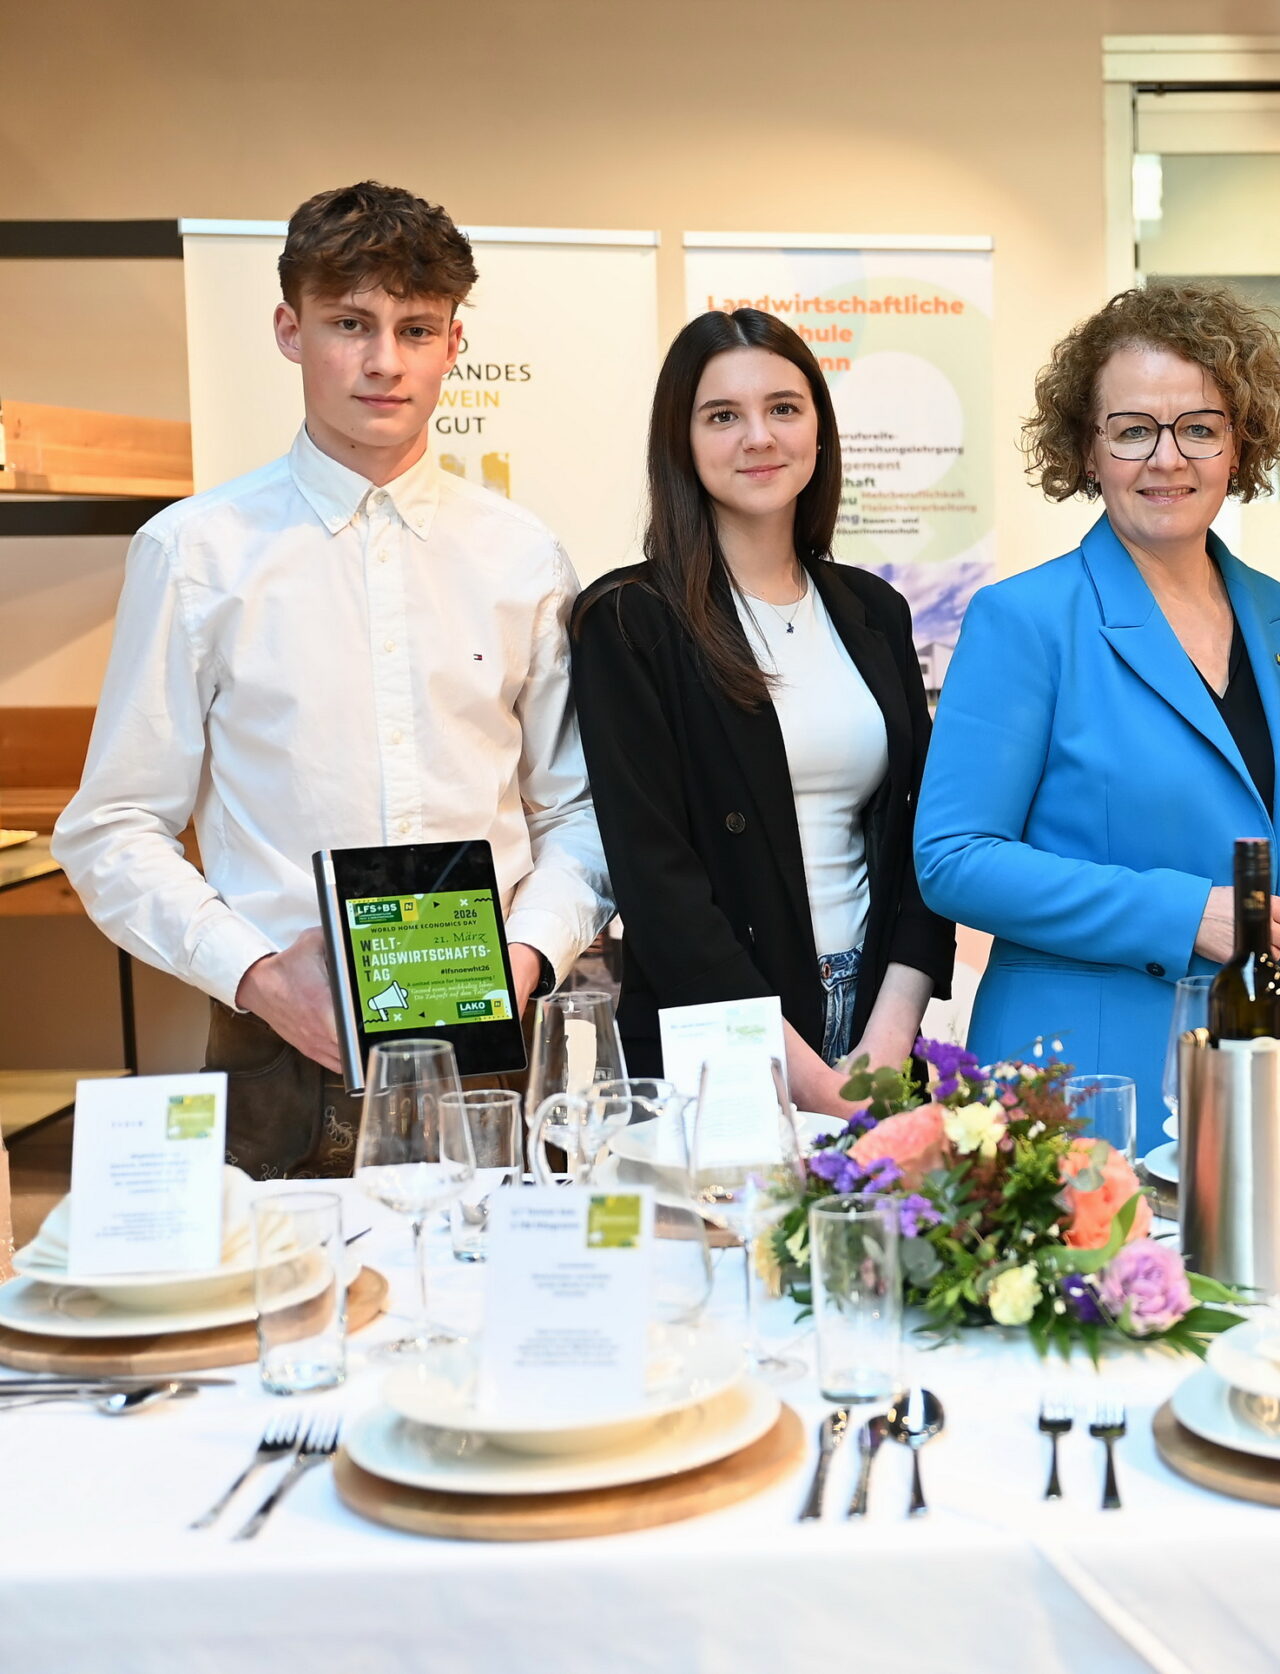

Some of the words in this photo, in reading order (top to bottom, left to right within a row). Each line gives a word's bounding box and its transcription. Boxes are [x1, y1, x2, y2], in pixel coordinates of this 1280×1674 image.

[707, 293, 966, 315] Landwirtschaftliche
[798, 324, 854, 344] hule
[441, 364, 531, 382] ANDES
[438, 390, 500, 408] WEIN
[435, 416, 486, 435] GUT
[843, 461, 901, 472] gement
[844, 476, 876, 488] haft
[357, 903, 398, 914] LFS+BS
[454, 908, 478, 920] 2026
[370, 926, 396, 934] WORLD
[398, 924, 419, 932] HOME
[420, 921, 462, 930] ECONOMICS
[360, 937, 401, 952] WELT-
[434, 935, 449, 944] 21.
[453, 931, 488, 944] März
[362, 944, 491, 968] HAUSWIRTSCHAFTS-
[364, 968, 390, 982] TAG
[460, 1001, 486, 1011] LAKO
